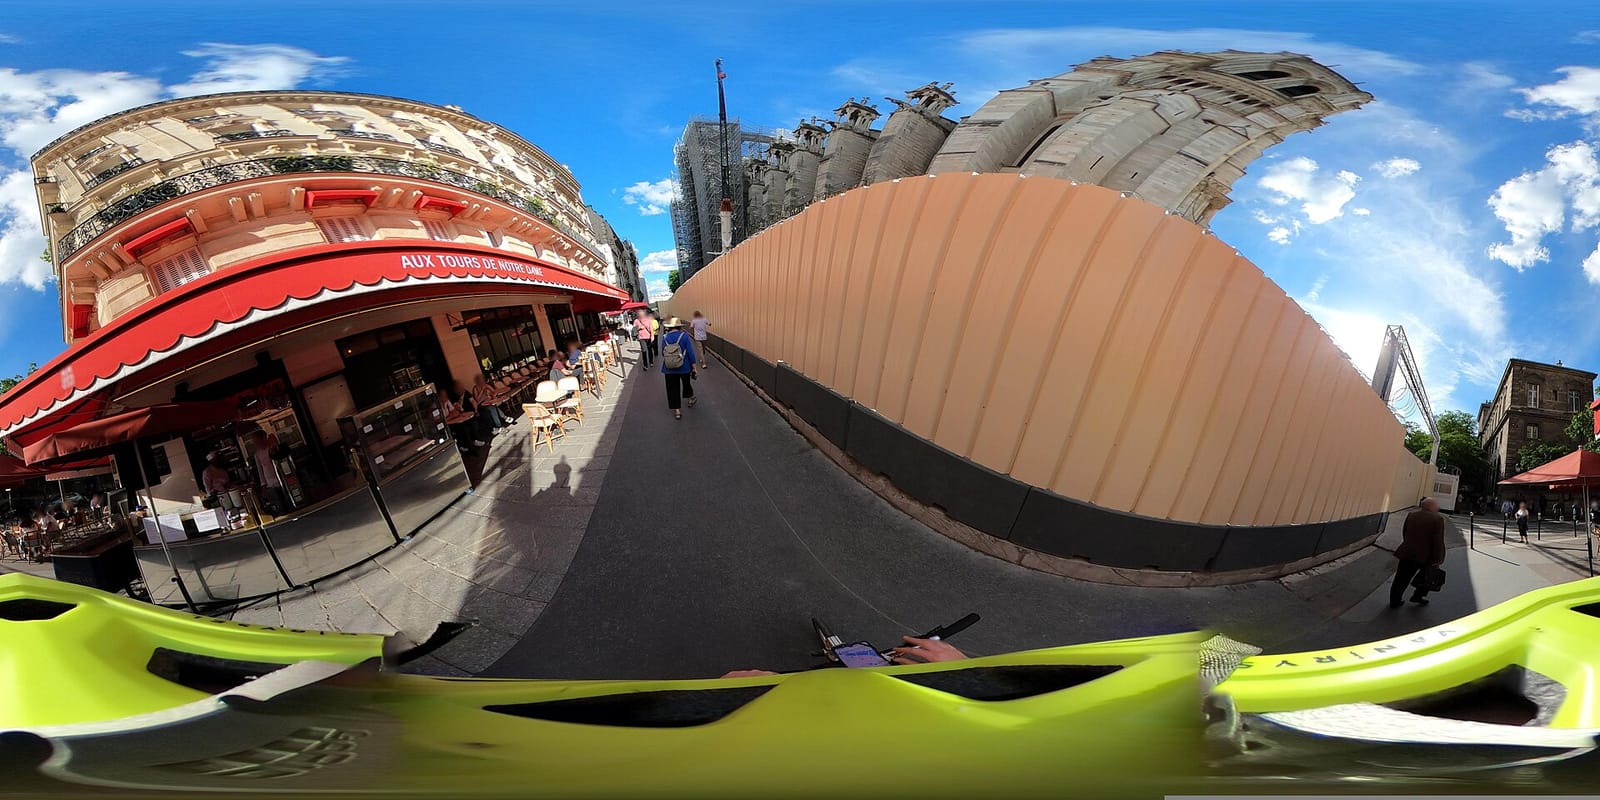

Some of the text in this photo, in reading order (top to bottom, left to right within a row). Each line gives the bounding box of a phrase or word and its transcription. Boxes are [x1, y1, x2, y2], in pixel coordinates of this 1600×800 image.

[401, 254, 435, 269] AUX
[436, 255, 480, 268] TOURS
[481, 258, 497, 269] DE
[498, 260, 525, 273] NOTRE
